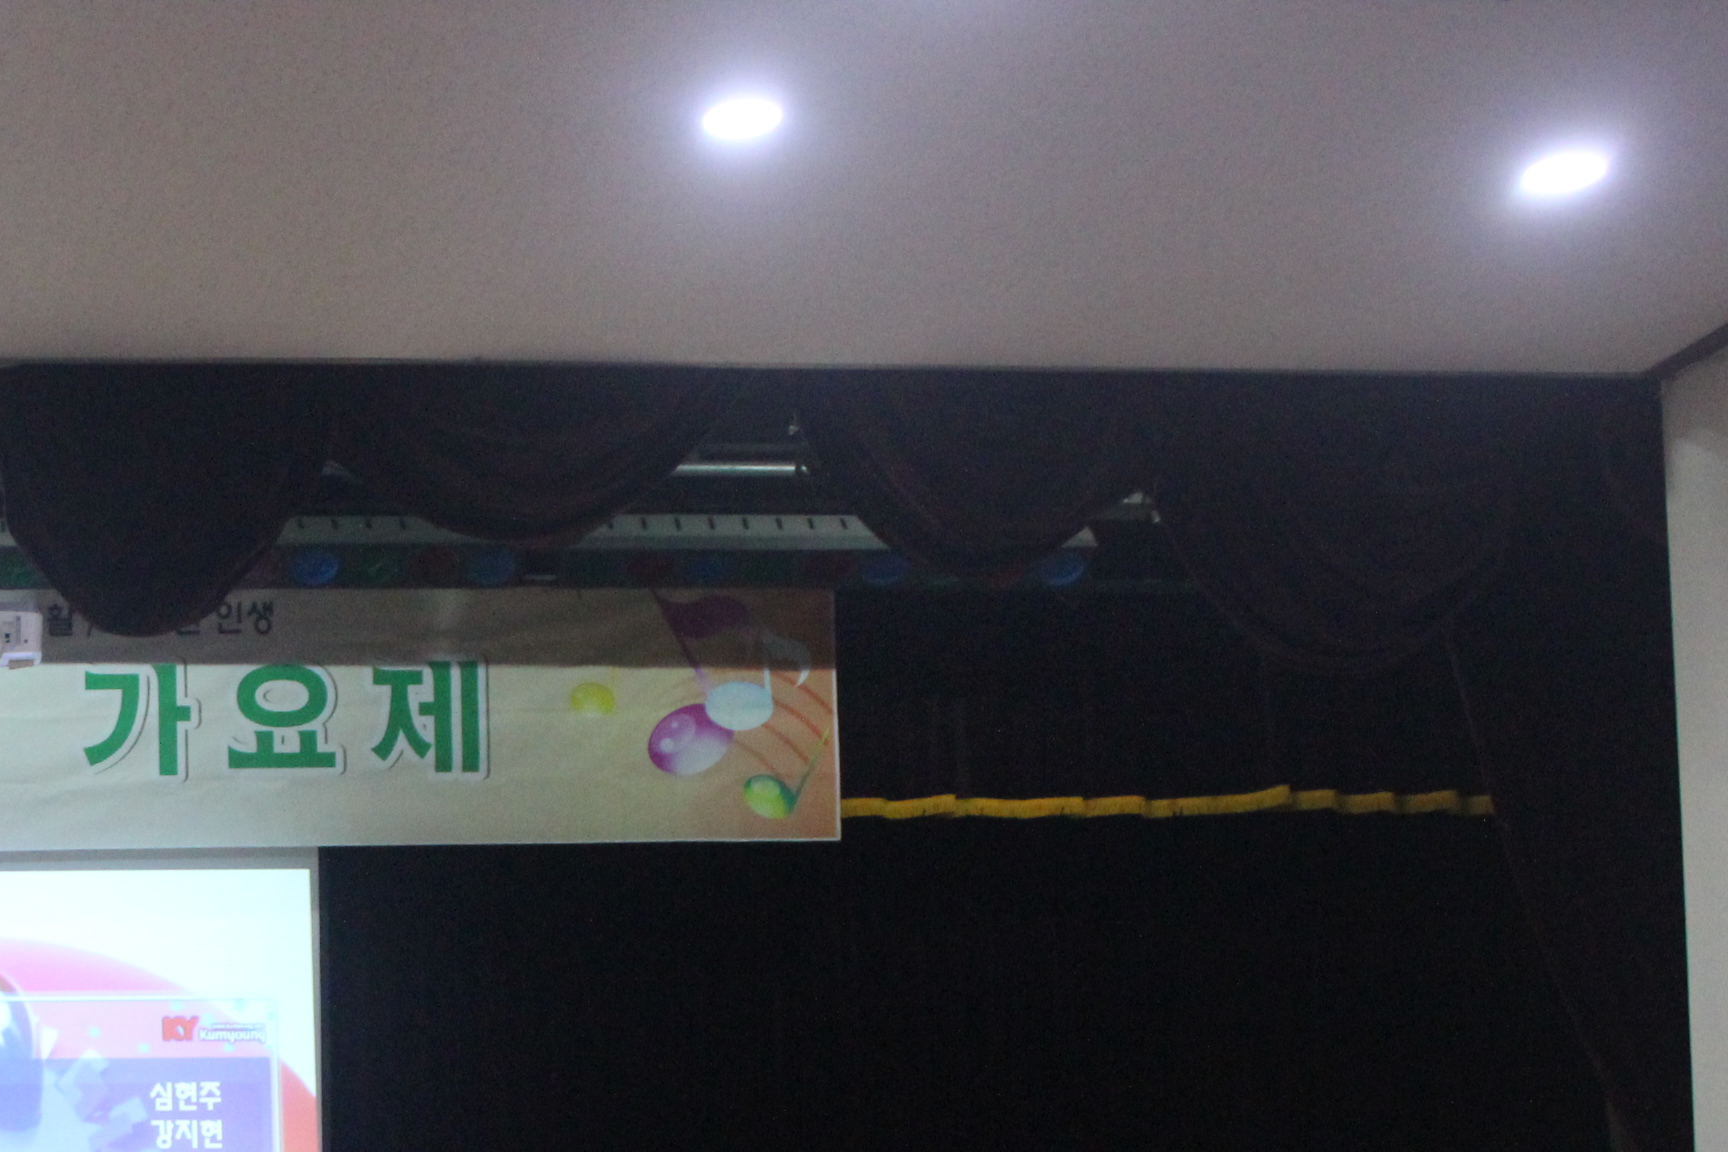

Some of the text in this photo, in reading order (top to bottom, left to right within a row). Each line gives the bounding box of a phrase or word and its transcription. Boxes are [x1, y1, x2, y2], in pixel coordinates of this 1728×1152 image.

[217, 600, 273, 636] 인생
[83, 659, 486, 780] 가요제
[198, 1029, 266, 1044] Kumyoung
[149, 1081, 222, 1111] 심현주
[150, 1119, 224, 1149] 강지현
